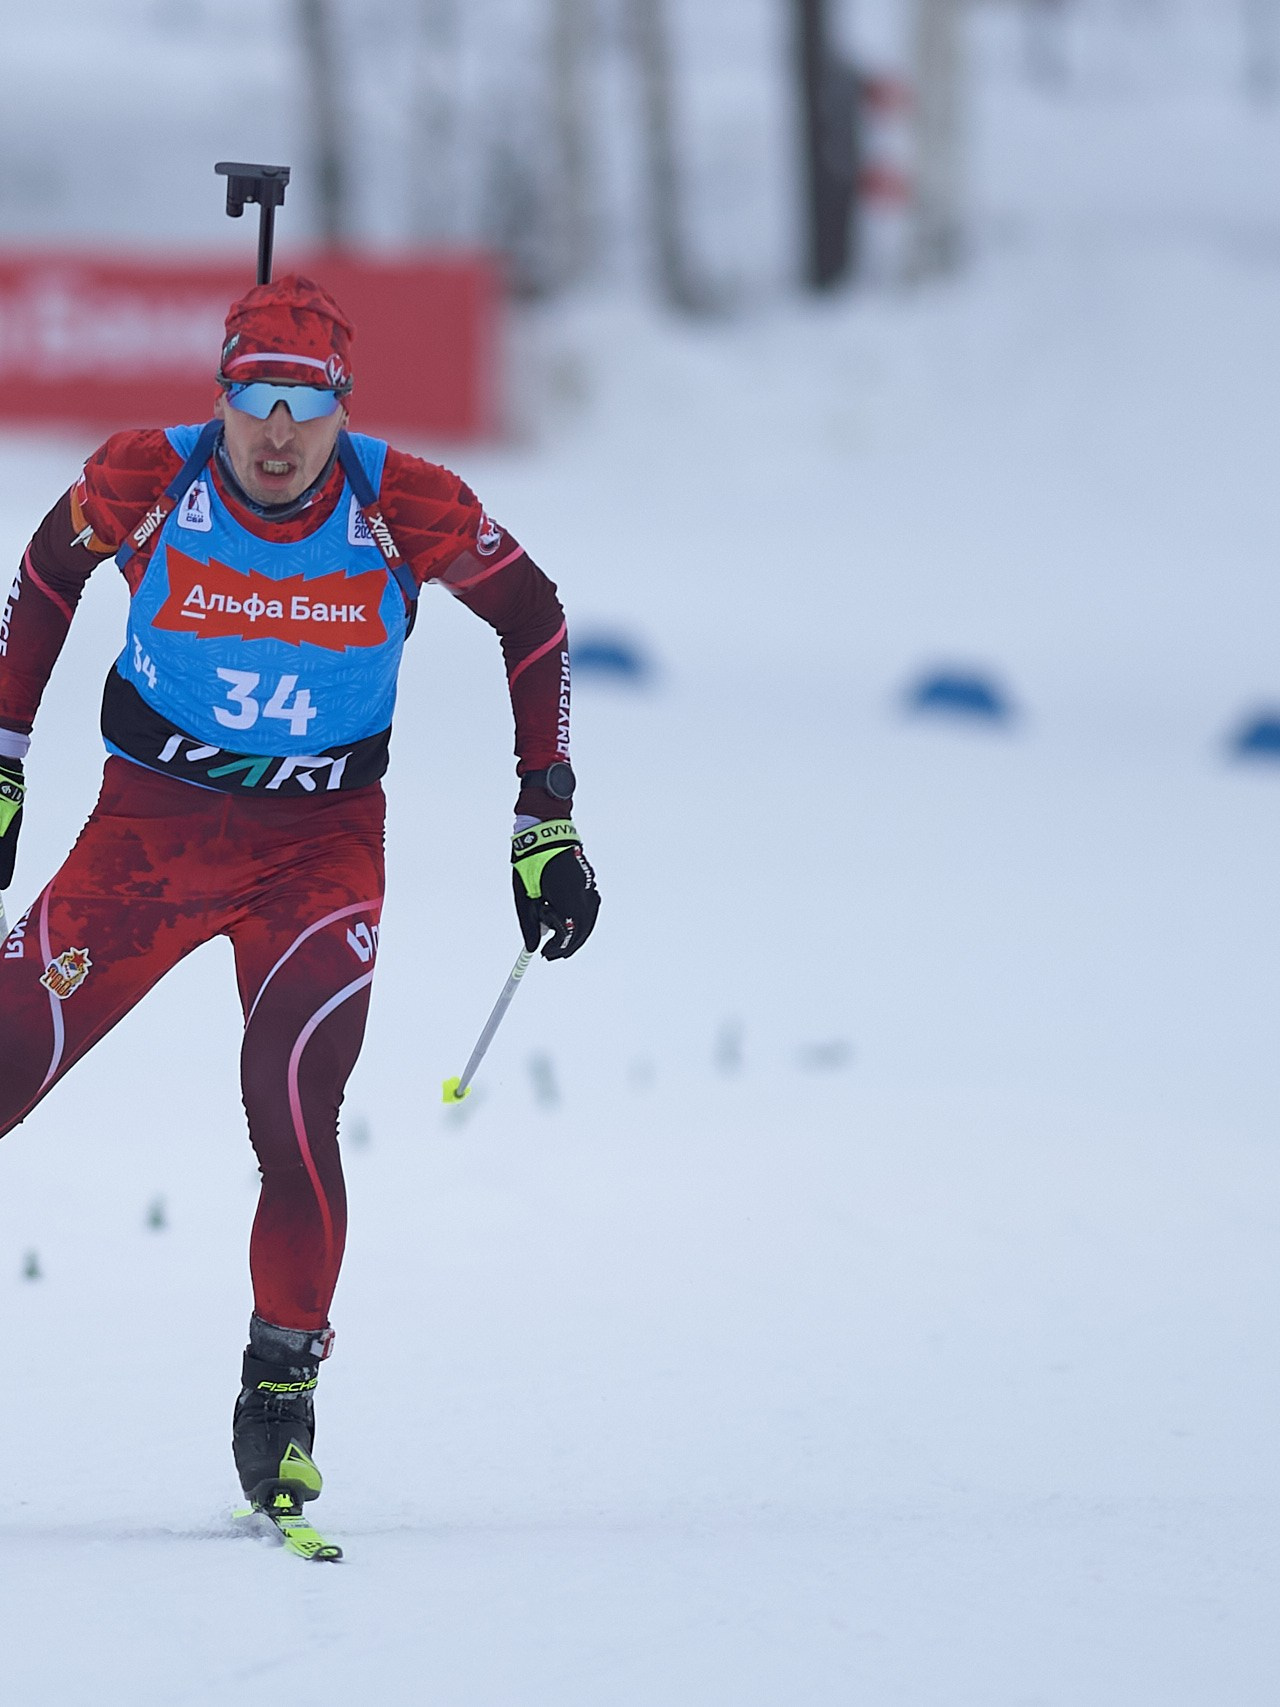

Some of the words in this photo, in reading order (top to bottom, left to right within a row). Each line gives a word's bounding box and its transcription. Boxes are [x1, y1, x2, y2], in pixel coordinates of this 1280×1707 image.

[181, 584, 283, 622] Альфа
[290, 596, 367, 622] Банк
[133, 633, 157, 689] 34
[212, 667, 317, 736] 34
[556, 651, 570, 763] ДМУРТИЯ
[257, 1378, 317, 1392] FISCHE
